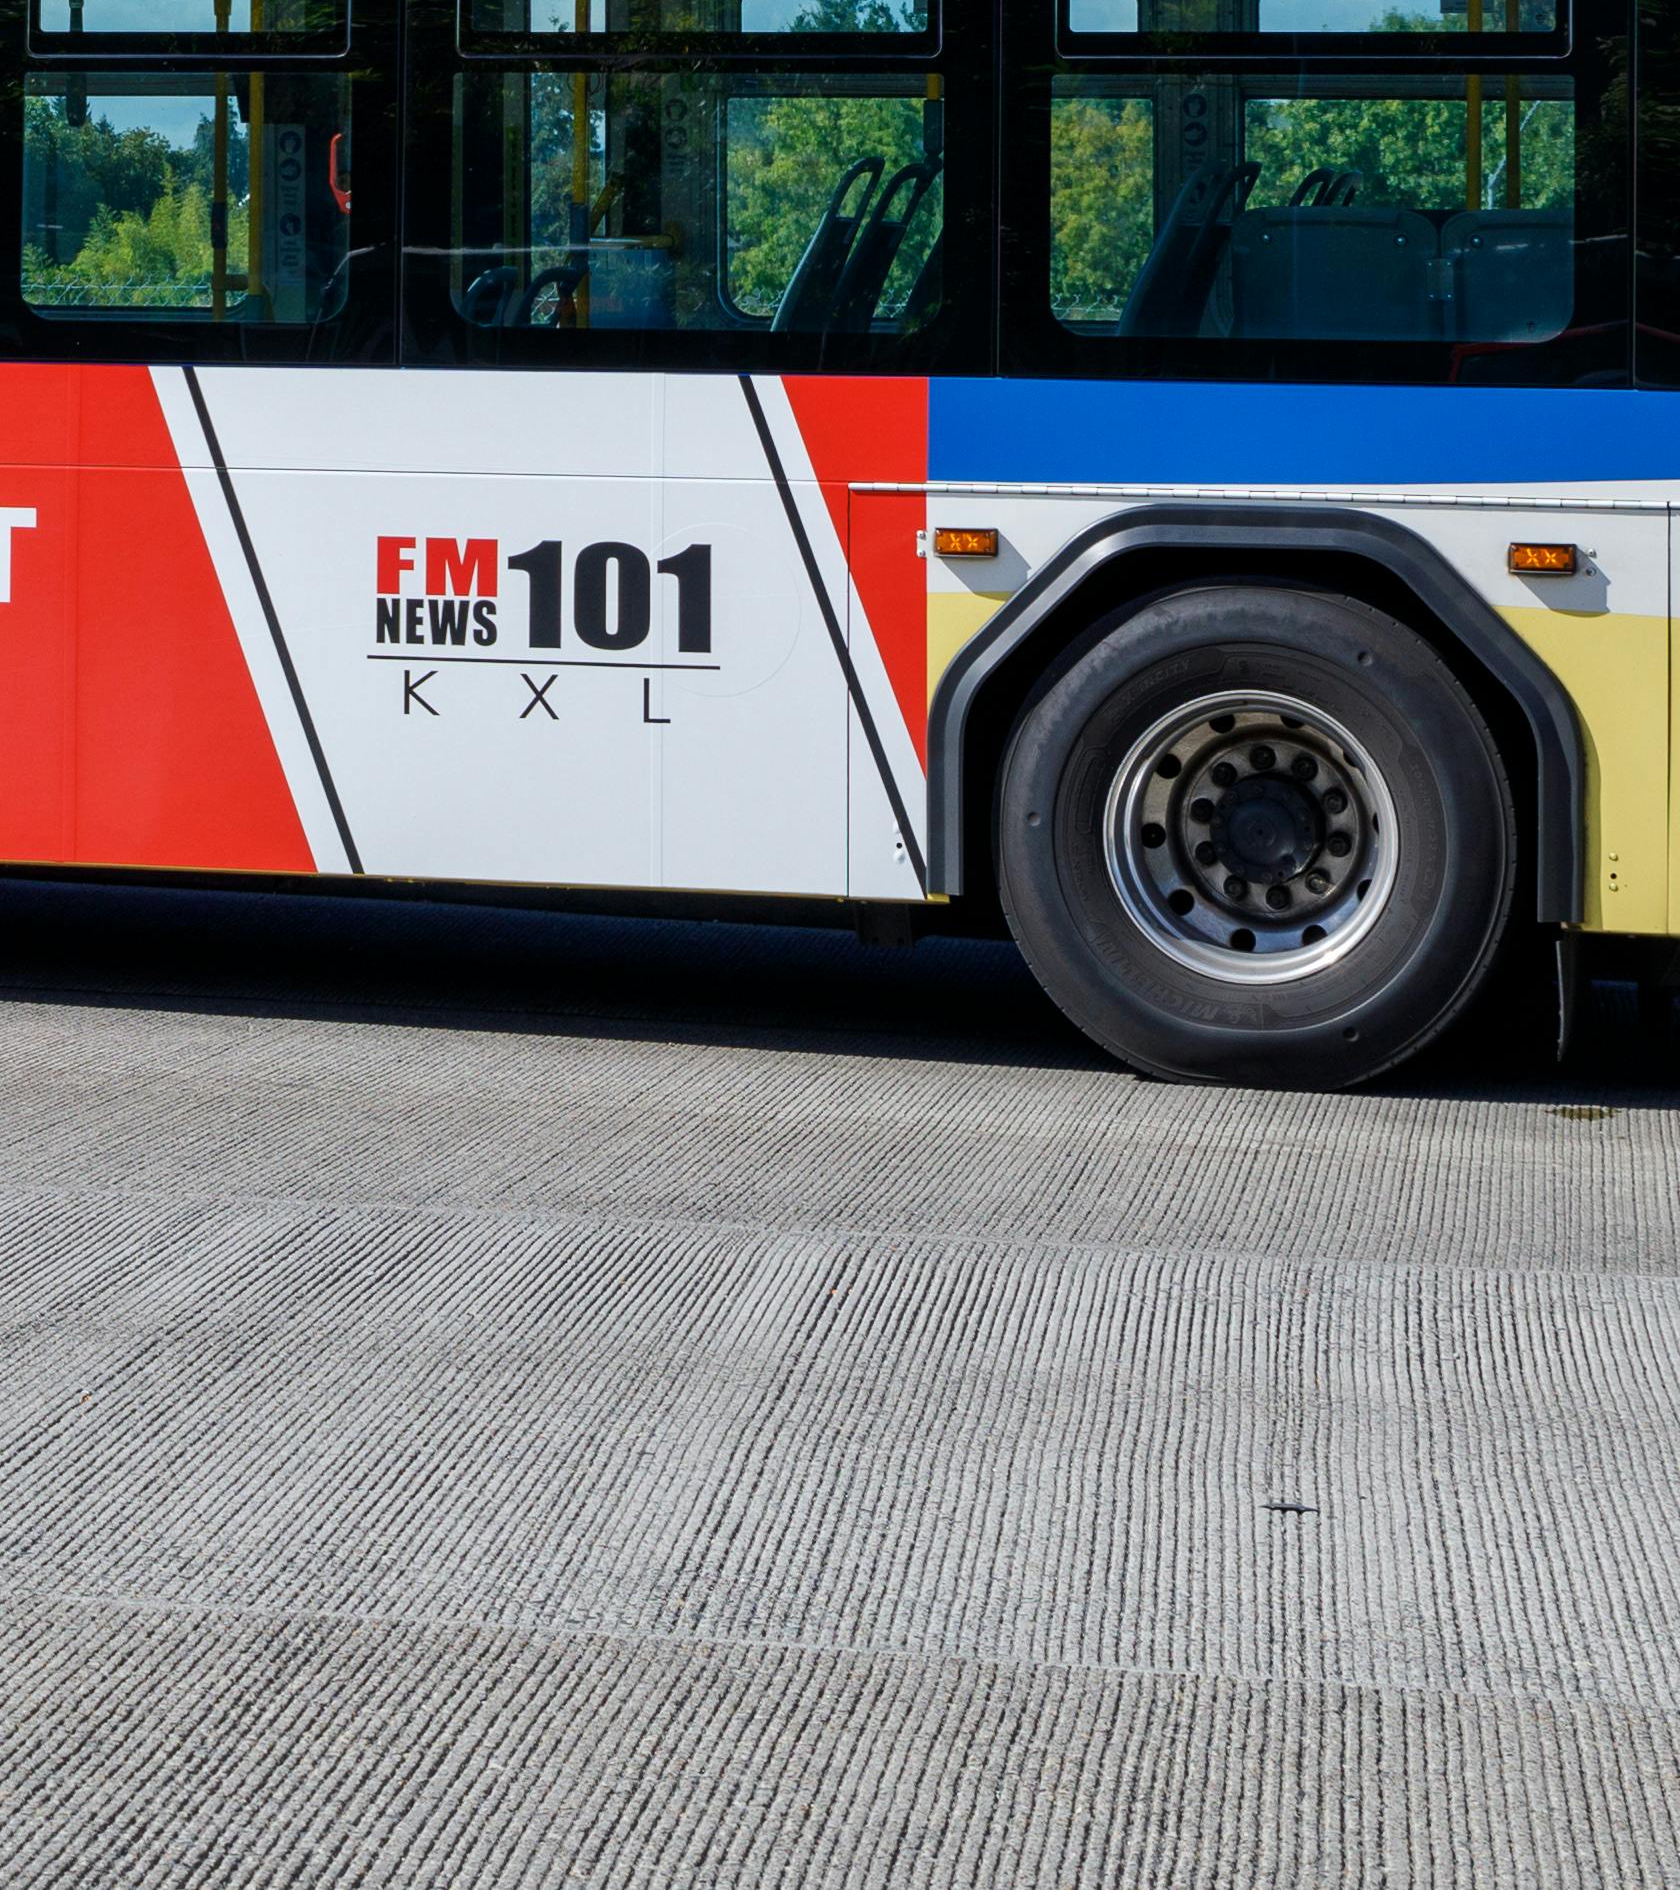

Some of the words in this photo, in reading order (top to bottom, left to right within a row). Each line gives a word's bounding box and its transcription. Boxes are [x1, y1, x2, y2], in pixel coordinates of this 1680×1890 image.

[377, 536, 499, 598] FM
[507, 540, 712, 654] 101
[376, 597, 498, 647] NEWS
